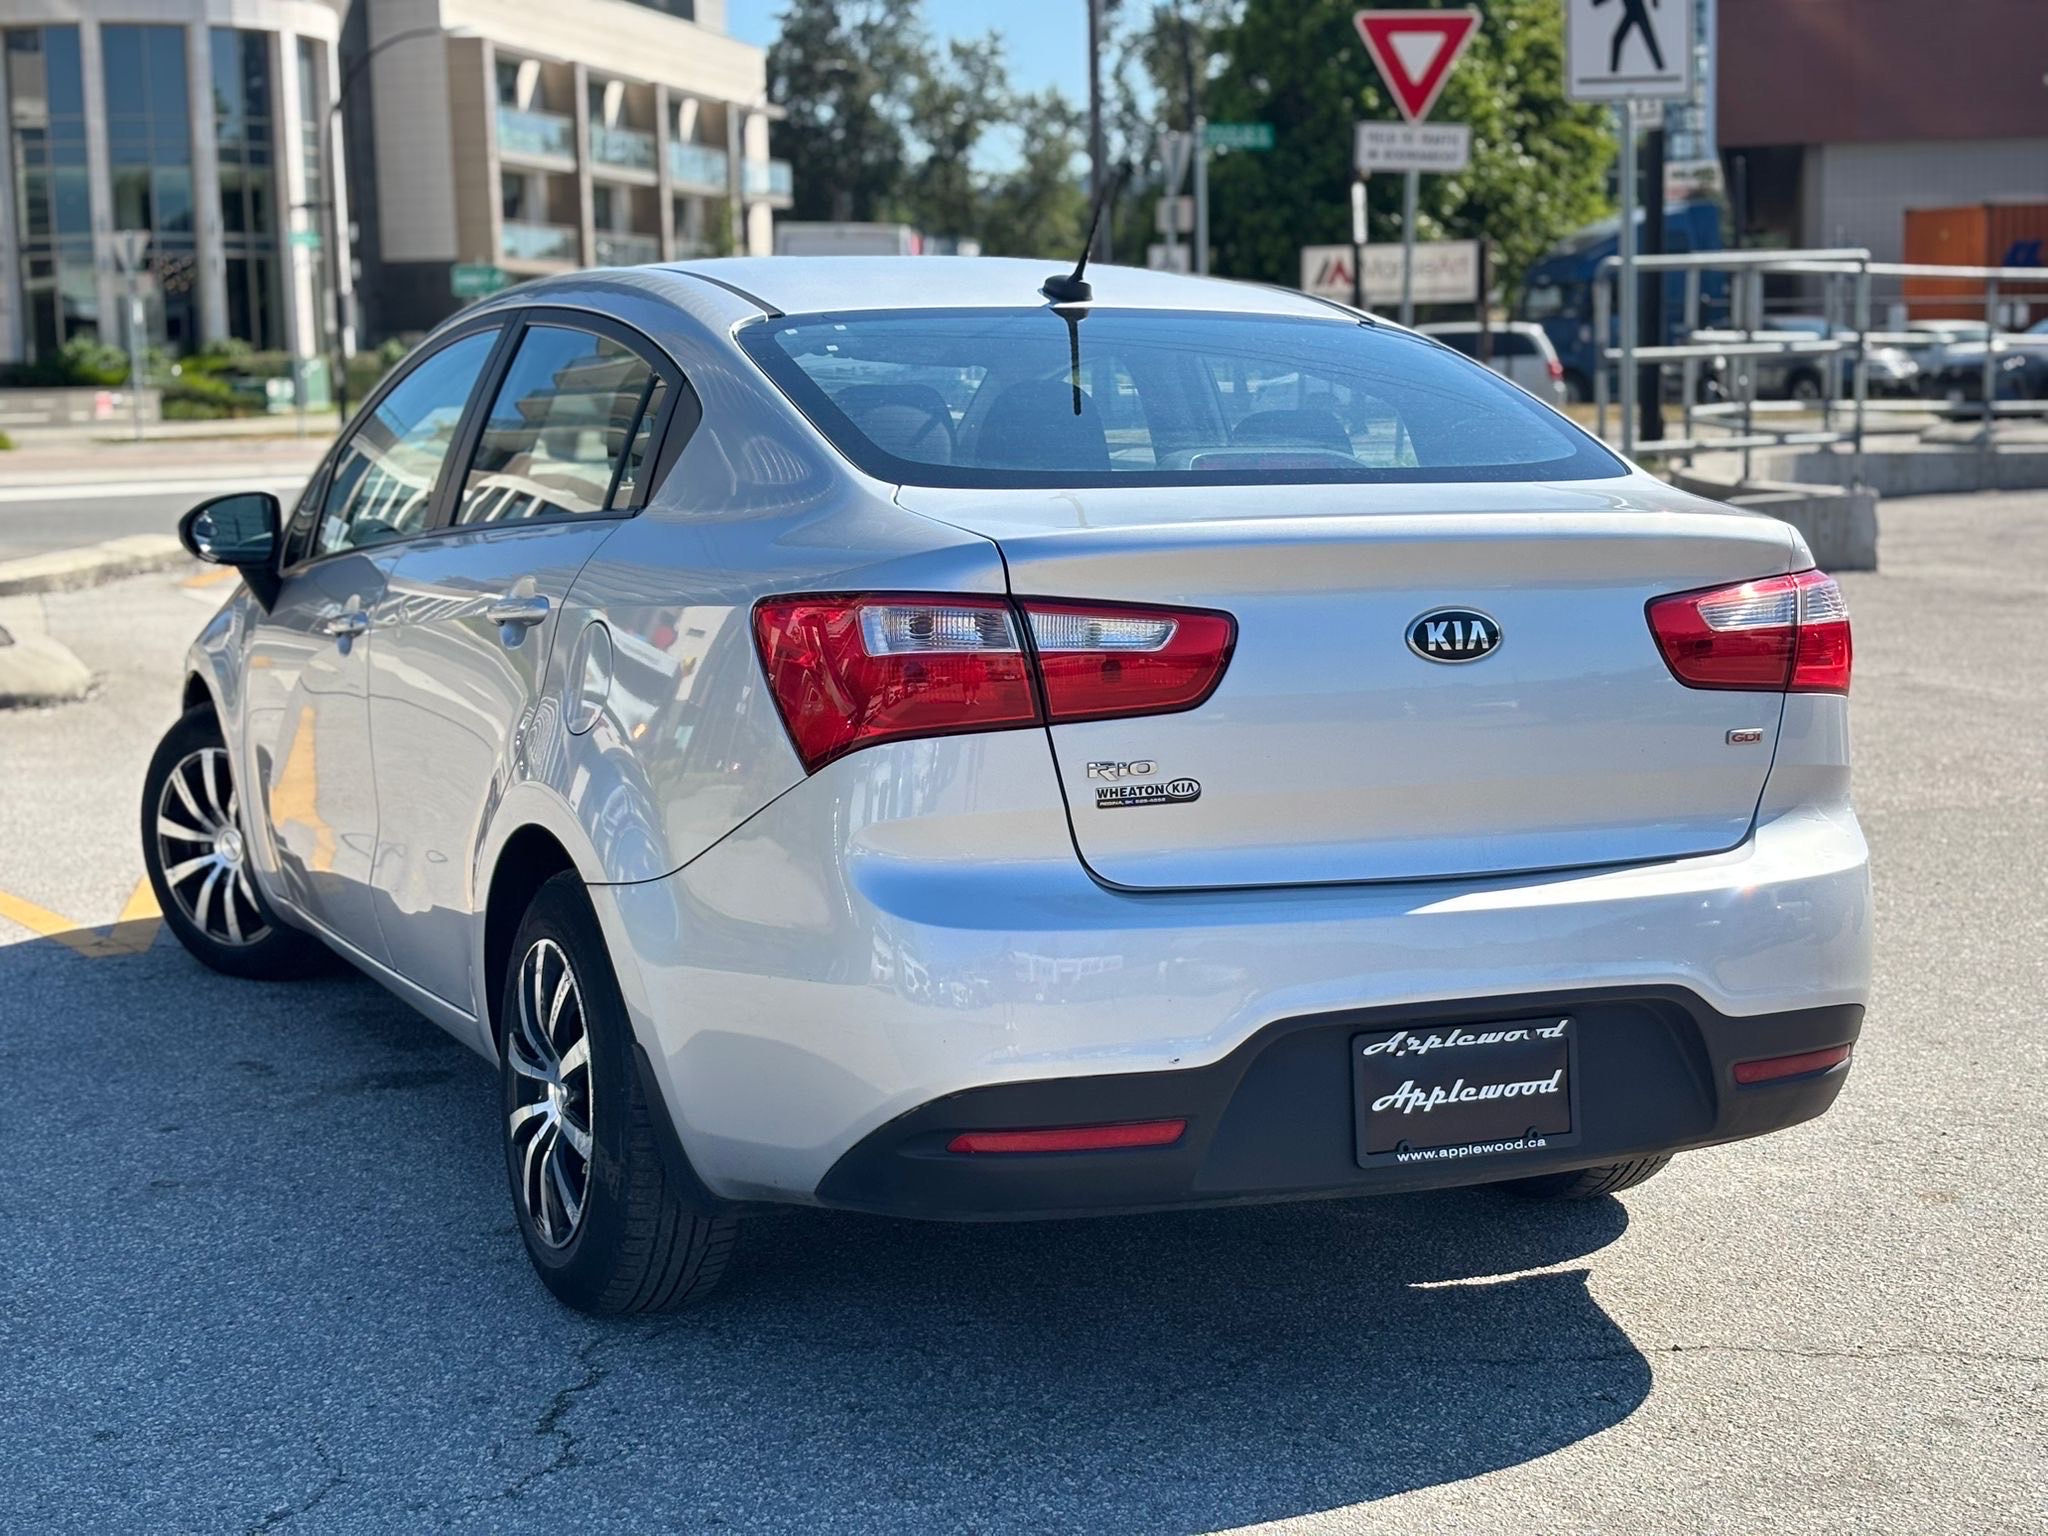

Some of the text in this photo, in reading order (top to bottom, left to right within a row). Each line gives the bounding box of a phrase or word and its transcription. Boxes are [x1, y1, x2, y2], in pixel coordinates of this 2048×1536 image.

[1424, 620, 1489, 651] KIA
[1731, 732, 1761, 743] GDI
[1087, 760, 1158, 781] RIO
[1097, 782, 1195, 799] WHEATON KIA
[1372, 1069, 1562, 1114] Applewood
[1397, 1137, 1546, 1162] www.applewood.ca
